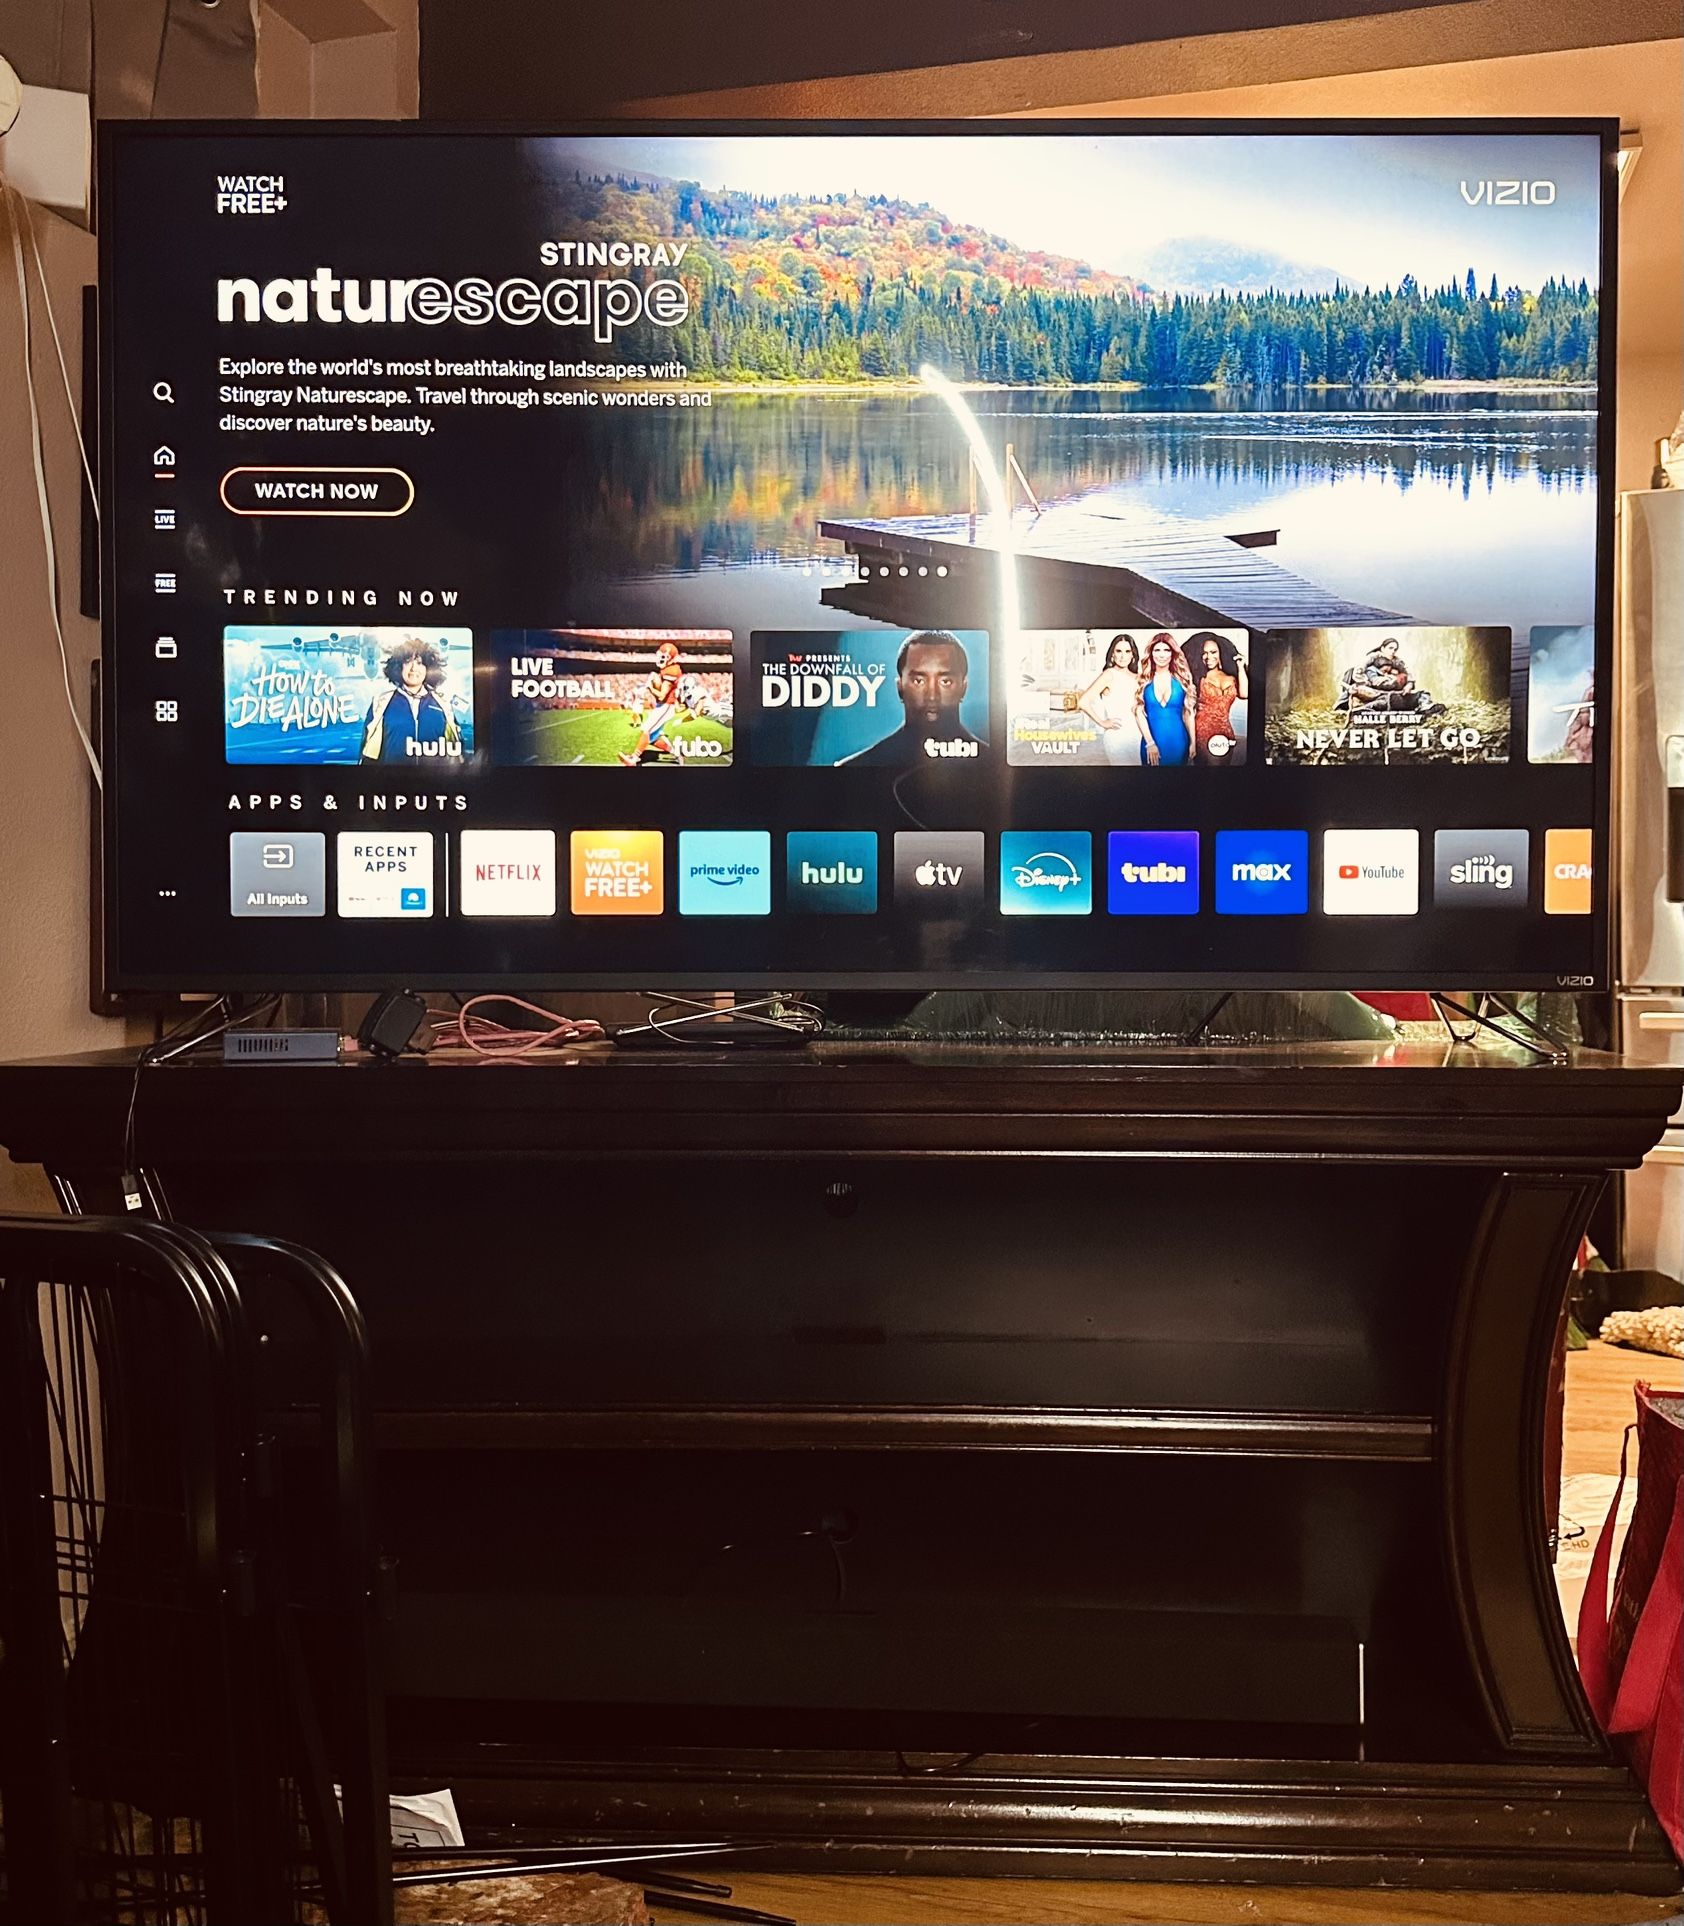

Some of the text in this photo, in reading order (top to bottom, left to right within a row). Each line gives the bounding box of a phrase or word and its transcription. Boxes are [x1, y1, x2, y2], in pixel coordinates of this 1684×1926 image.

[218, 176, 283, 192] WATCH
[1460, 181, 1556, 205] VIZIO
[217, 193, 287, 213] FREE+
[539, 242, 689, 266] STINGRAY
[217, 267, 689, 343] naturescape
[220, 358, 687, 382] Explore the world's most breathtaking landscapes with
[220, 386, 712, 408] Stingray Naturescape. Travel through scenic wonders and
[220, 414, 434, 435] discover nature's beauty.
[255, 483, 378, 499] WATCH NOW
[155, 515, 175, 524] LIVE
[155, 579, 176, 588] FREE
[224, 589, 457, 606] TRENDING NOW
[511, 657, 554, 676] LIVE
[806, 655, 851, 663] PRESENTS
[762, 663, 886, 676] THE DOWNFALL OF
[252, 662, 336, 697] How to
[511, 680, 614, 699] FOOTBALL
[762, 676, 886, 707] DIDDY
[231, 692, 360, 732] DIE ALONE
[1390, 714, 1422, 724] BERRY
[1014, 728, 1096, 741] Housewives
[1296, 727, 1481, 750] NEVER LET GO
[405, 737, 462, 757] hulu
[672, 736, 723, 758] fubo
[923, 738, 979, 758] tubi
[1031, 741, 1080, 754] VAULT
[229, 795, 466, 810] APPS & INPUTS
[354, 846, 418, 857] RECENT
[365, 861, 407, 872] APPS
[476, 864, 542, 881] NETFLIX
[585, 861, 649, 877] WATCH
[690, 863, 760, 877] prime video
[800, 861, 864, 885] hulu
[936, 863, 963, 885] tv
[1011, 860, 1082, 892] Disney+
[1121, 863, 1186, 883] tubi
[1232, 862, 1292, 881] max
[1362, 865, 1405, 880] YouTube
[1450, 855, 1513, 889] sling
[1554, 863, 1592, 880] CRA
[585, 877, 653, 897] FREE+
[247, 893, 308, 907] All Inputs
[1557, 976, 1594, 986] VIZIO
